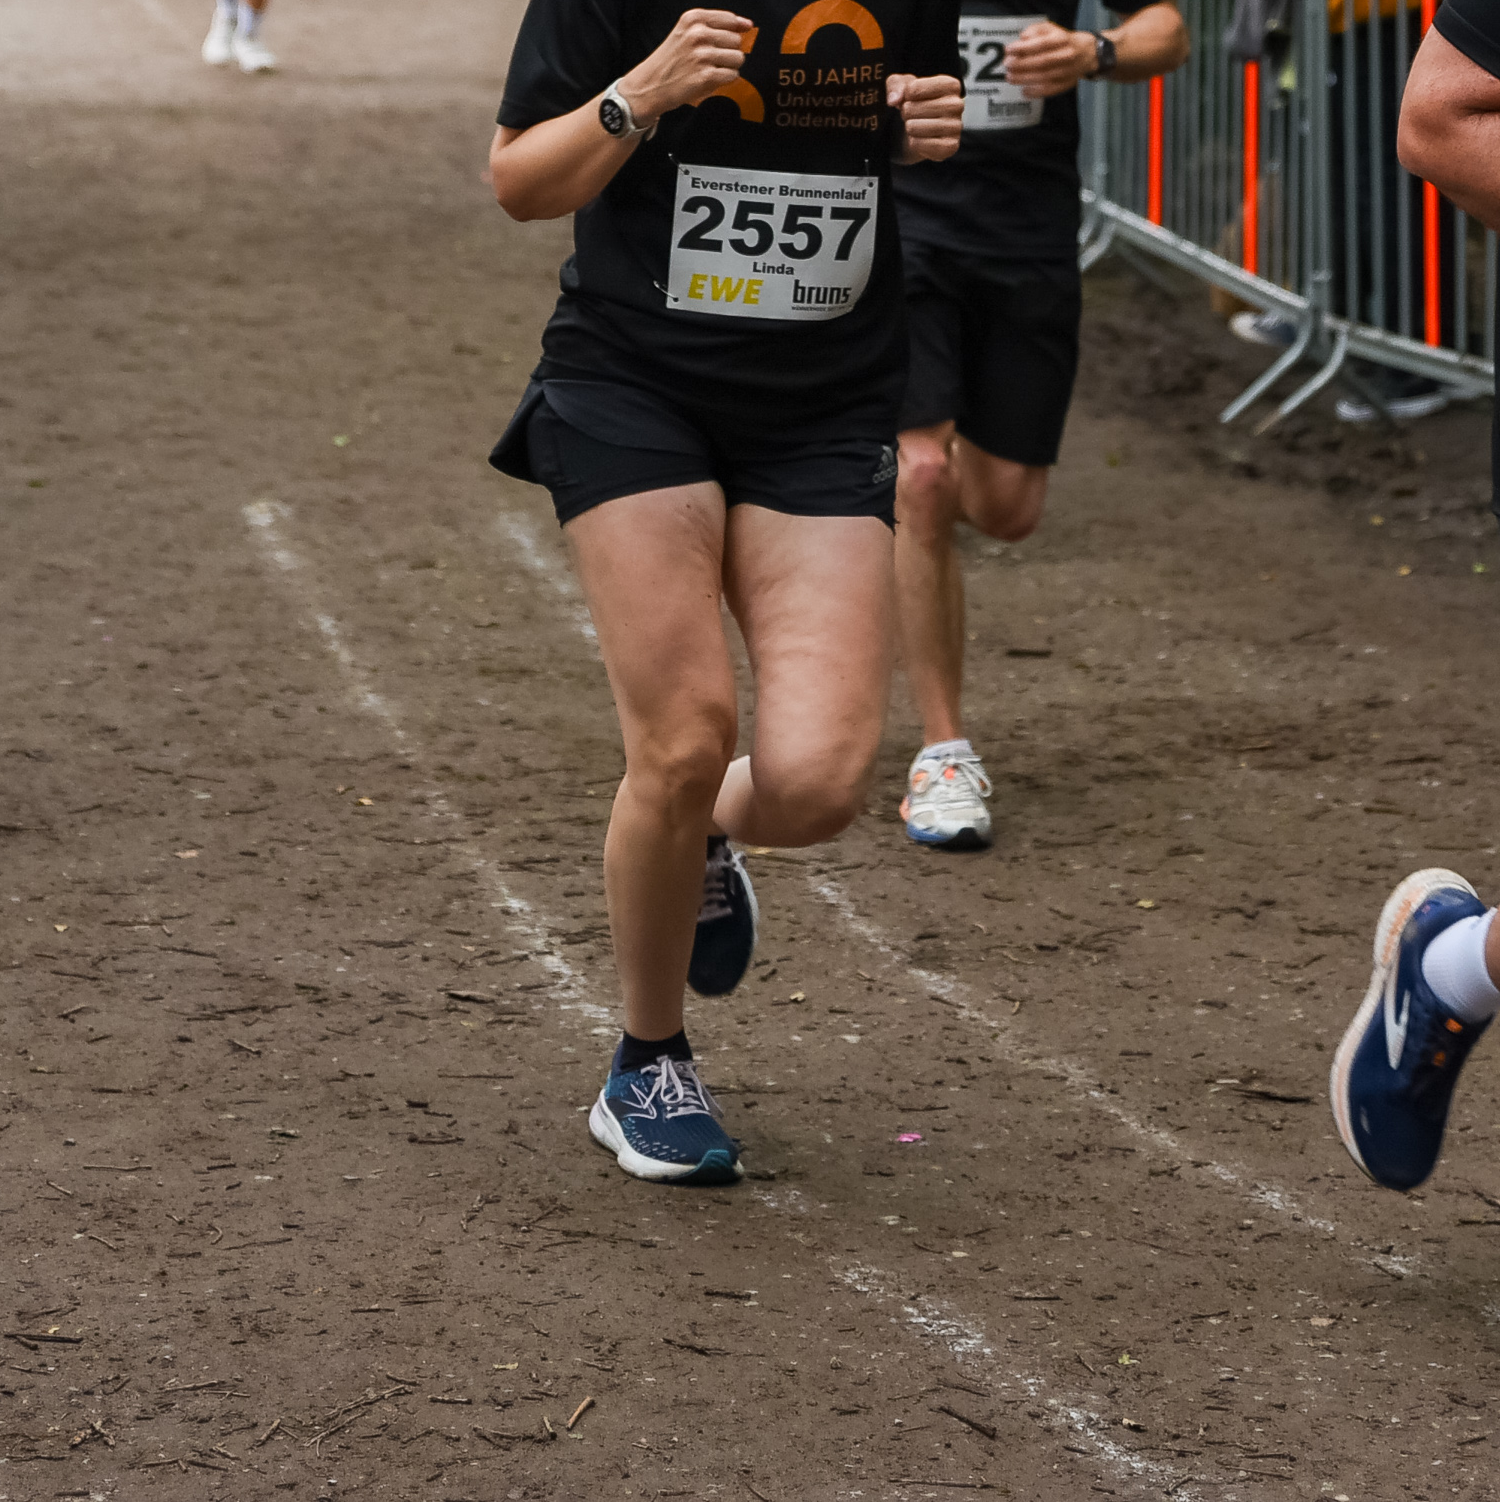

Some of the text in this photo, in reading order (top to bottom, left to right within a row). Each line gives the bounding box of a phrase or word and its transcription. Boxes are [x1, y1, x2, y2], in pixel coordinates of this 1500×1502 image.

[778, 63, 884, 86] 50 JAHRE
[775, 112, 879, 131] Oldenburg
[690, 177, 868, 201] Everstener Brunnenlauf
[677, 195, 872, 261] 2557
[752, 261, 795, 276] Linda
[687, 273, 764, 305] EWE
[792, 279, 853, 305] bruns
